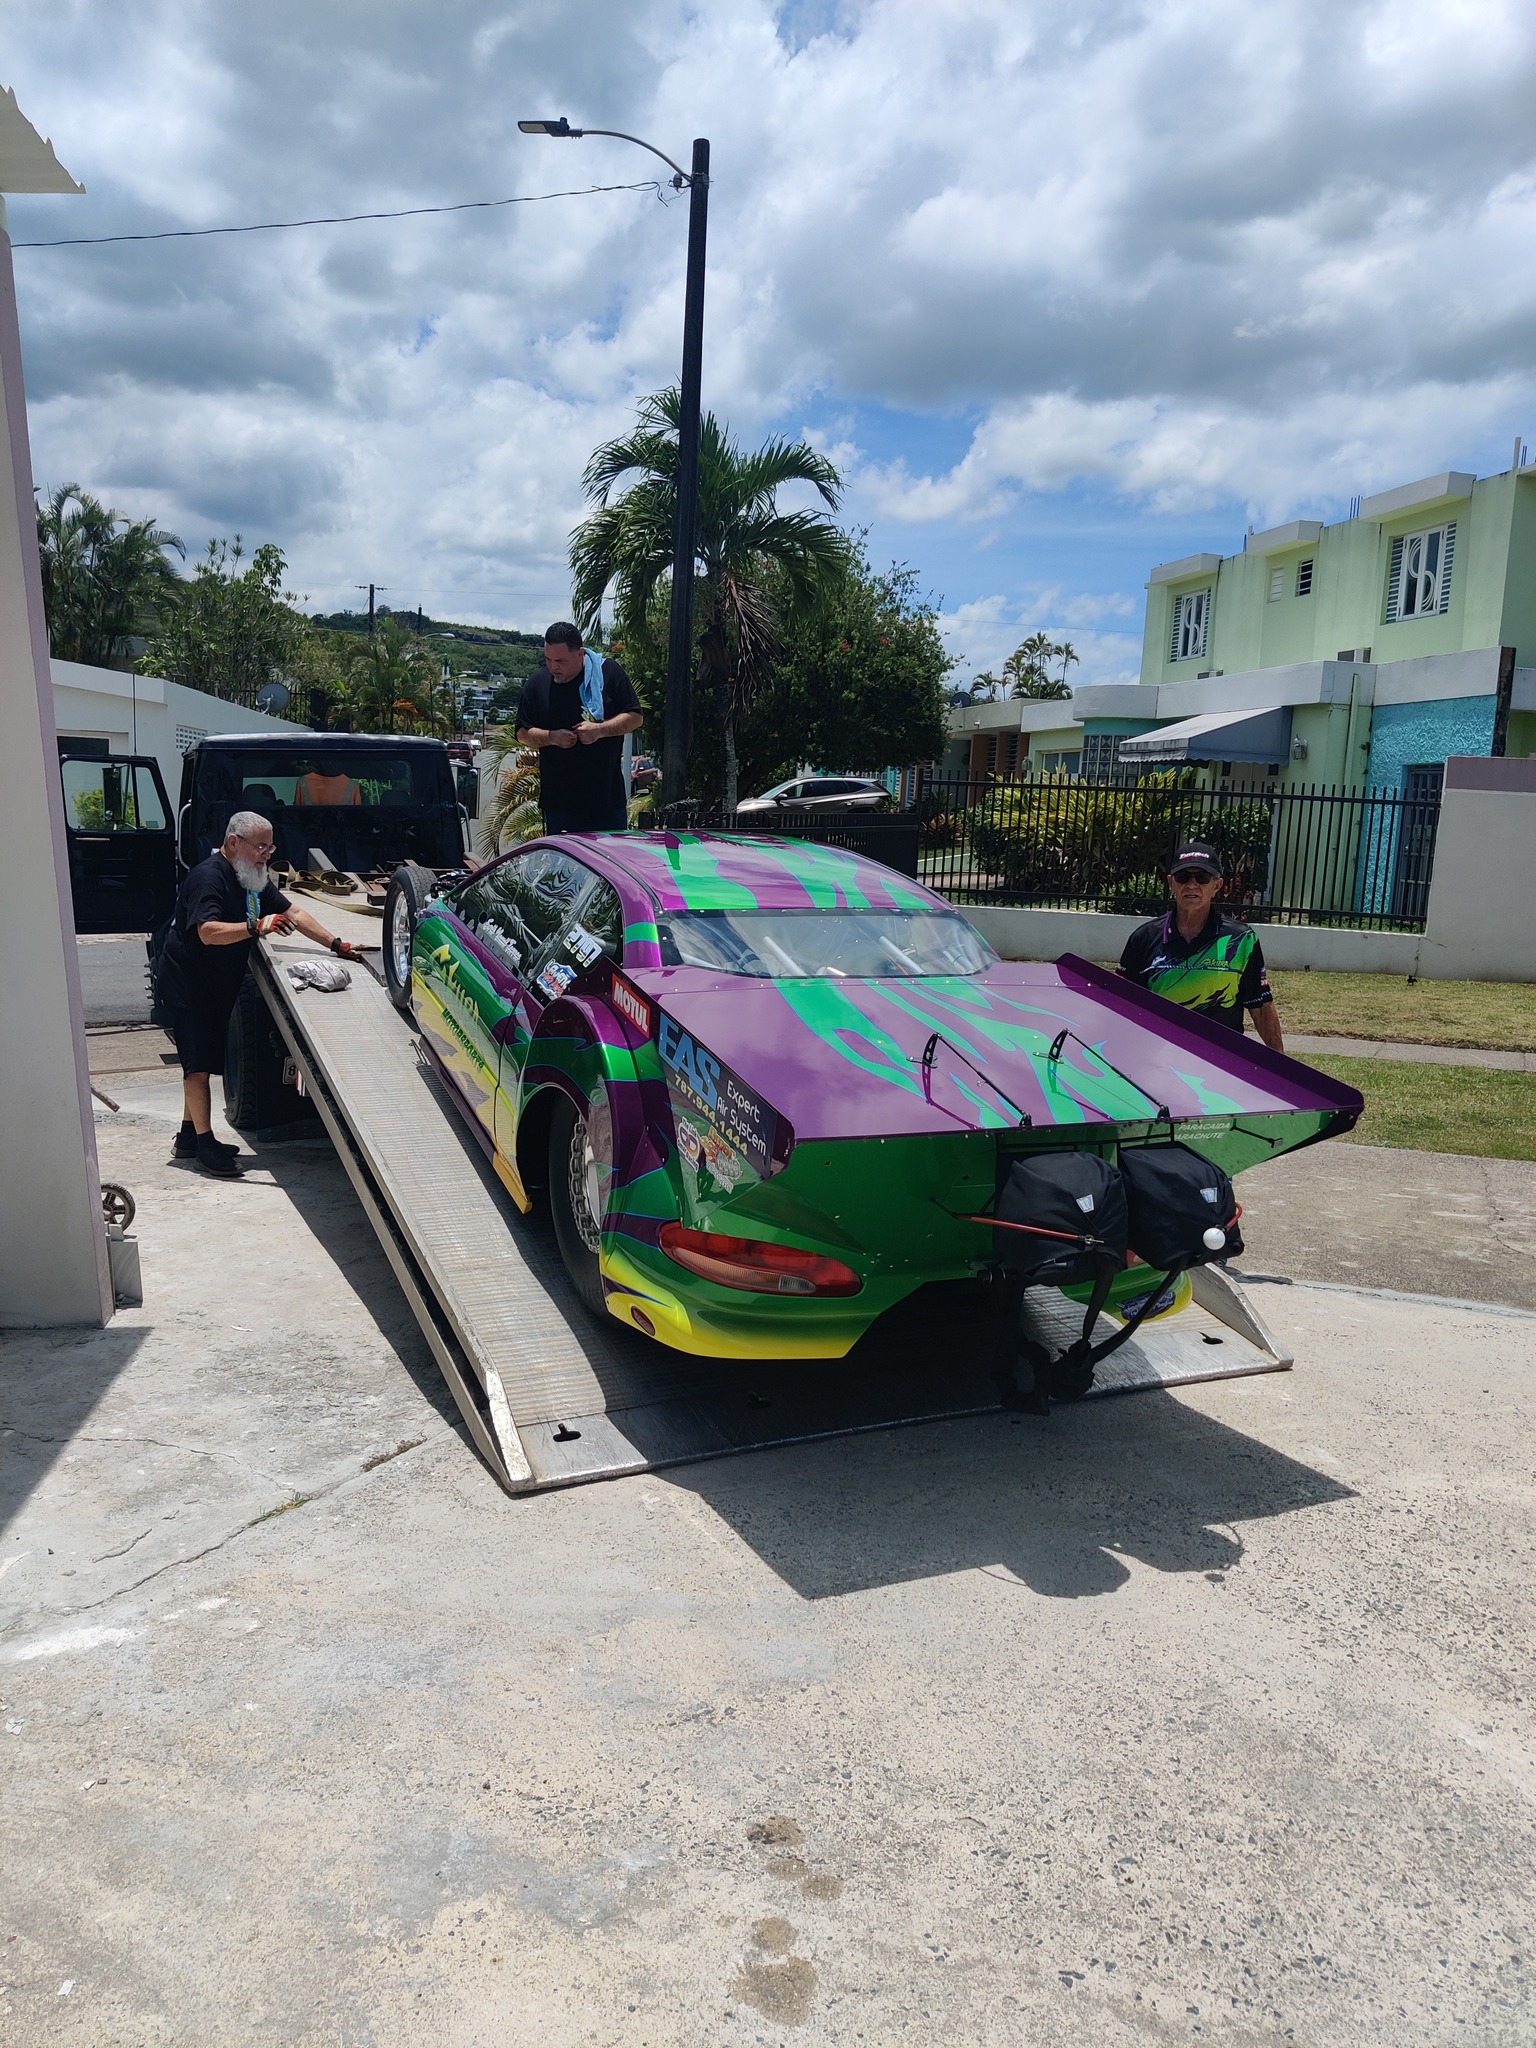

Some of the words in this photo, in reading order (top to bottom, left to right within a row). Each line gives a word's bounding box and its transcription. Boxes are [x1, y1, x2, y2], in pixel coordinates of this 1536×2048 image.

[563, 923, 602, 968] 2797
[613, 982, 649, 1034] MOTUL
[658, 1011, 721, 1110] EAS
[674, 1073, 749, 1156] 787.944.1444
[716, 1096, 729, 1117] Air
[729, 1110, 767, 1156] System
[726, 1080, 760, 1123] Expert
[1174, 1132, 1226, 1140] ARACHUTE
